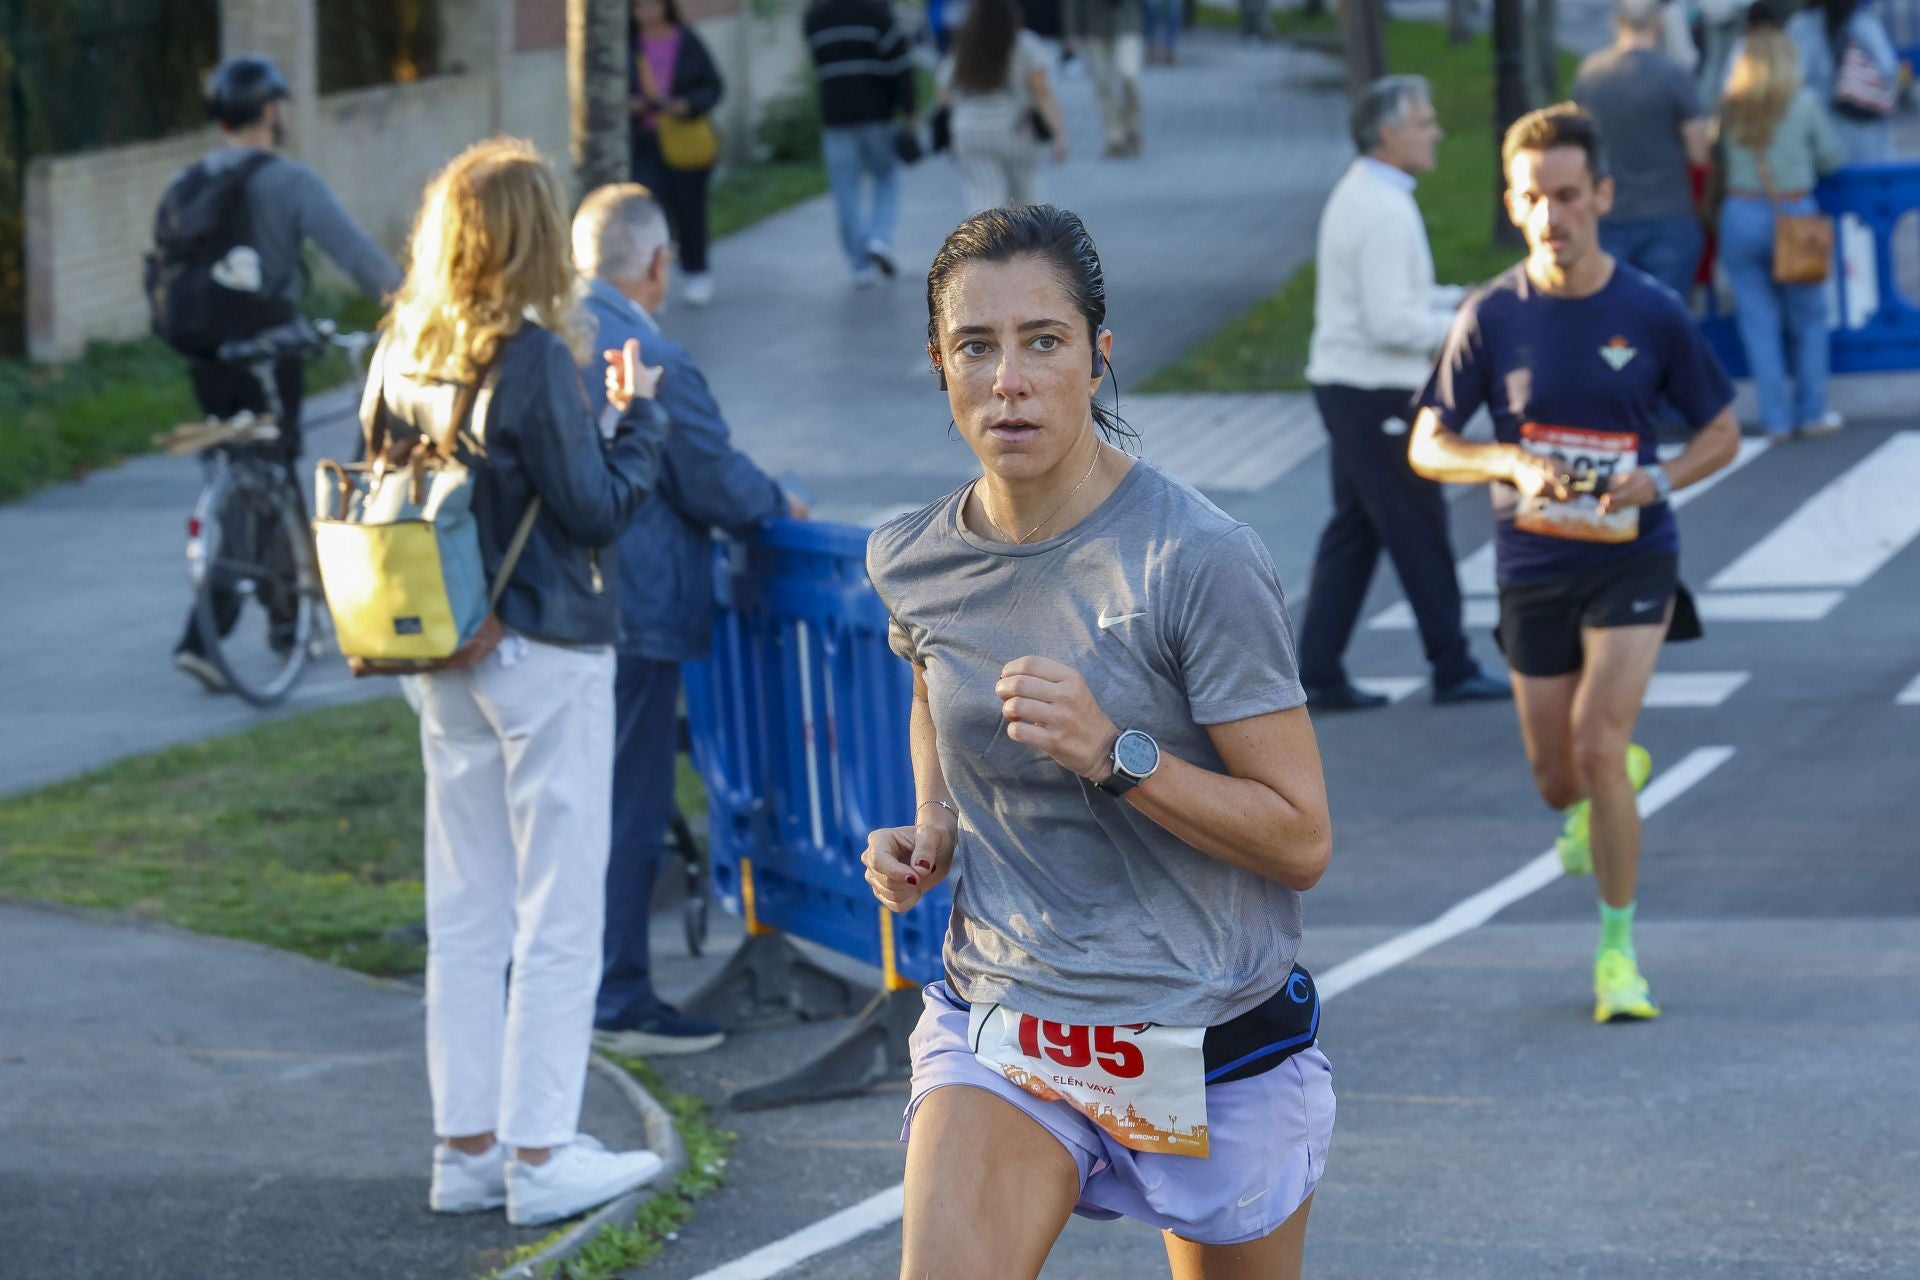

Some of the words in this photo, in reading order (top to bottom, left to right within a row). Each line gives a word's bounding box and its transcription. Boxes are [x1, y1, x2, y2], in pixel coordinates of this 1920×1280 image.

[1019, 1012, 1144, 1078] 195
[1051, 1075, 1083, 1087] ELÉN
[1086, 1082, 1115, 1095] VAYÁ
